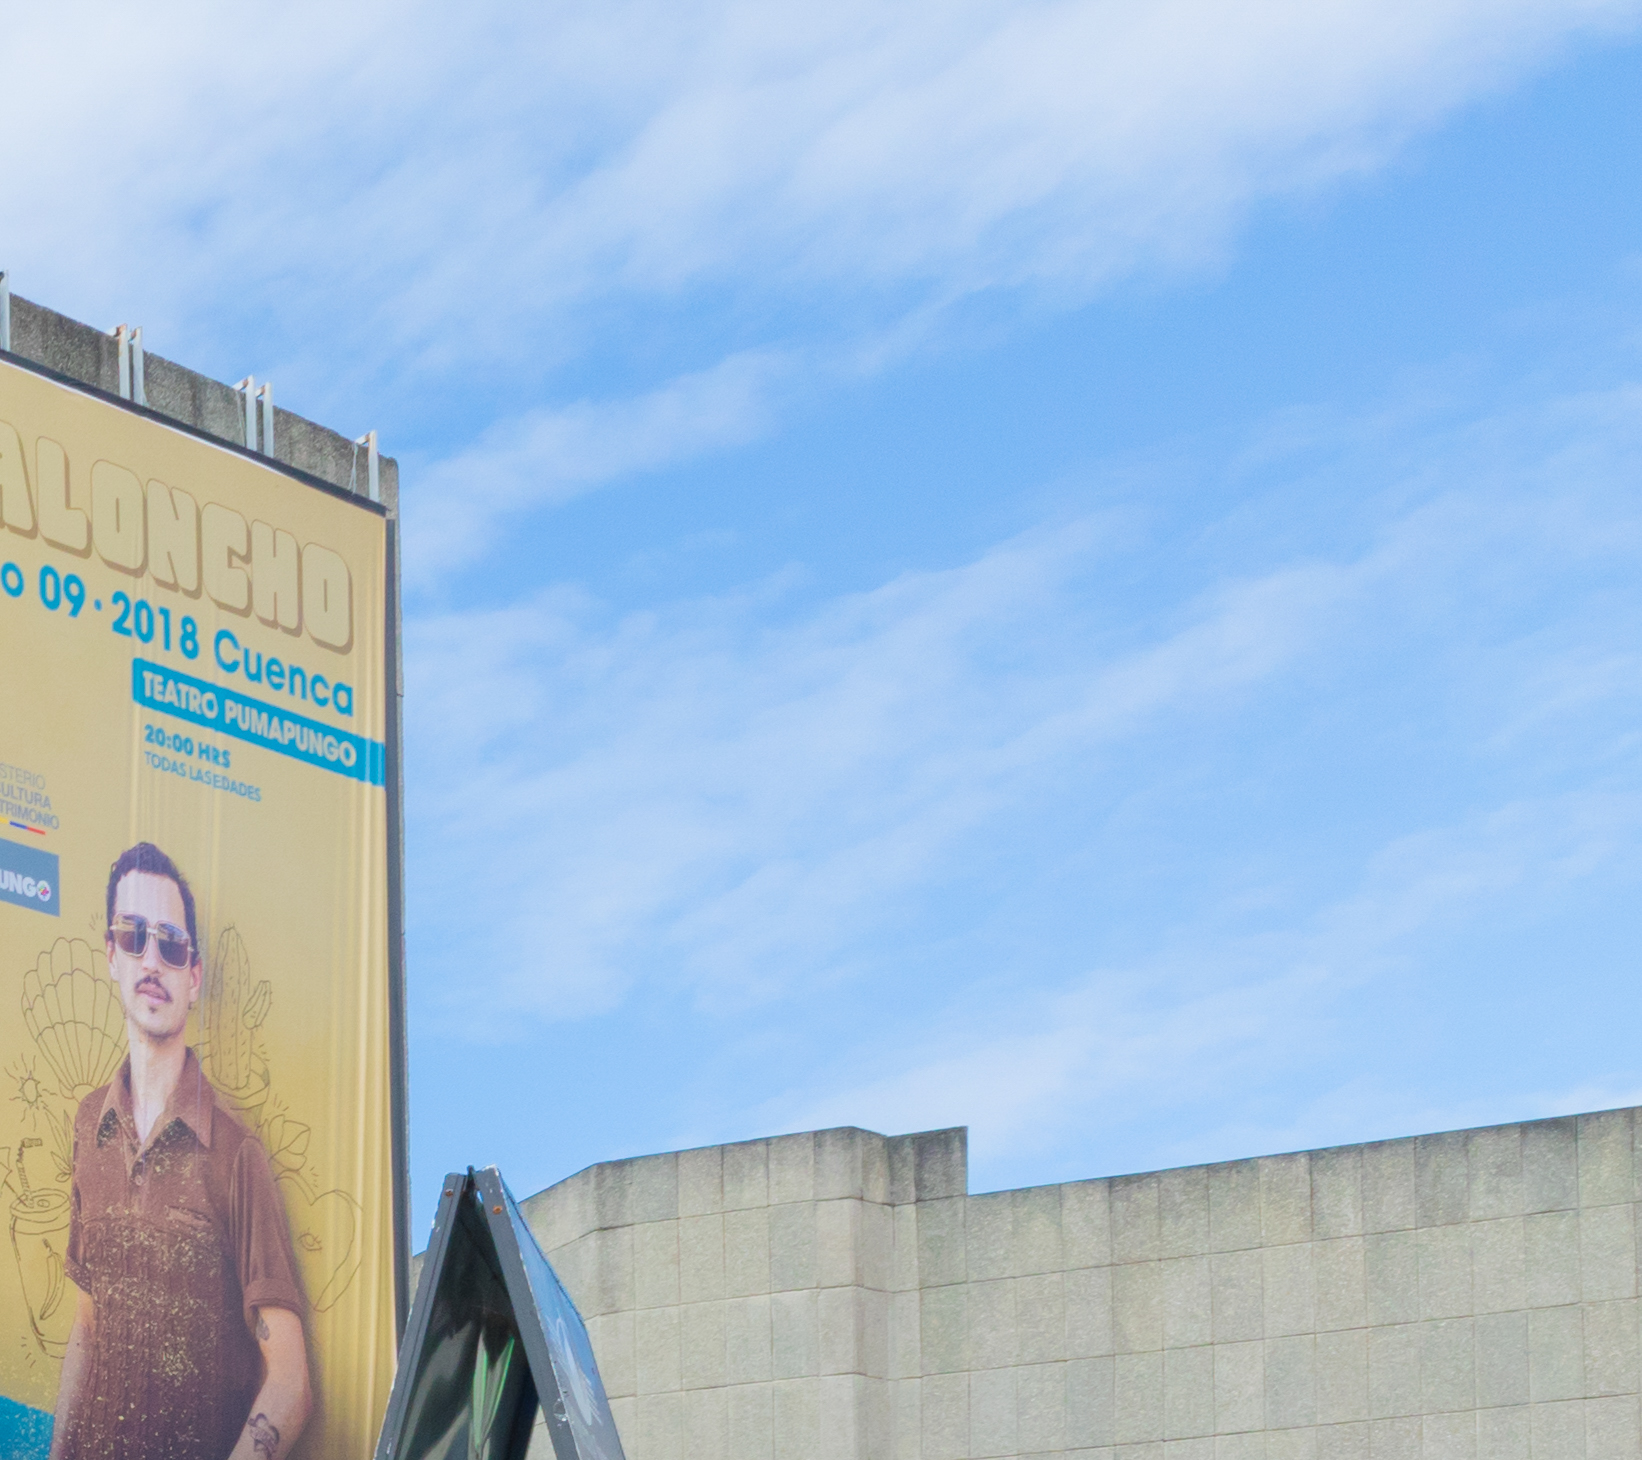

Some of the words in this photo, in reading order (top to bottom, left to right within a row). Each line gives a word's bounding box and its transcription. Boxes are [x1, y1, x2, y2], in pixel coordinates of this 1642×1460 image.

[214, 629, 354, 717] Cuenca
[142, 670, 219, 719] TEATRO
[224, 699, 357, 767] PUMAPUNGO
[144, 724, 194, 756] 20:00
[198, 742, 231, 769] HRS
[144, 751, 186, 777] TODAS
